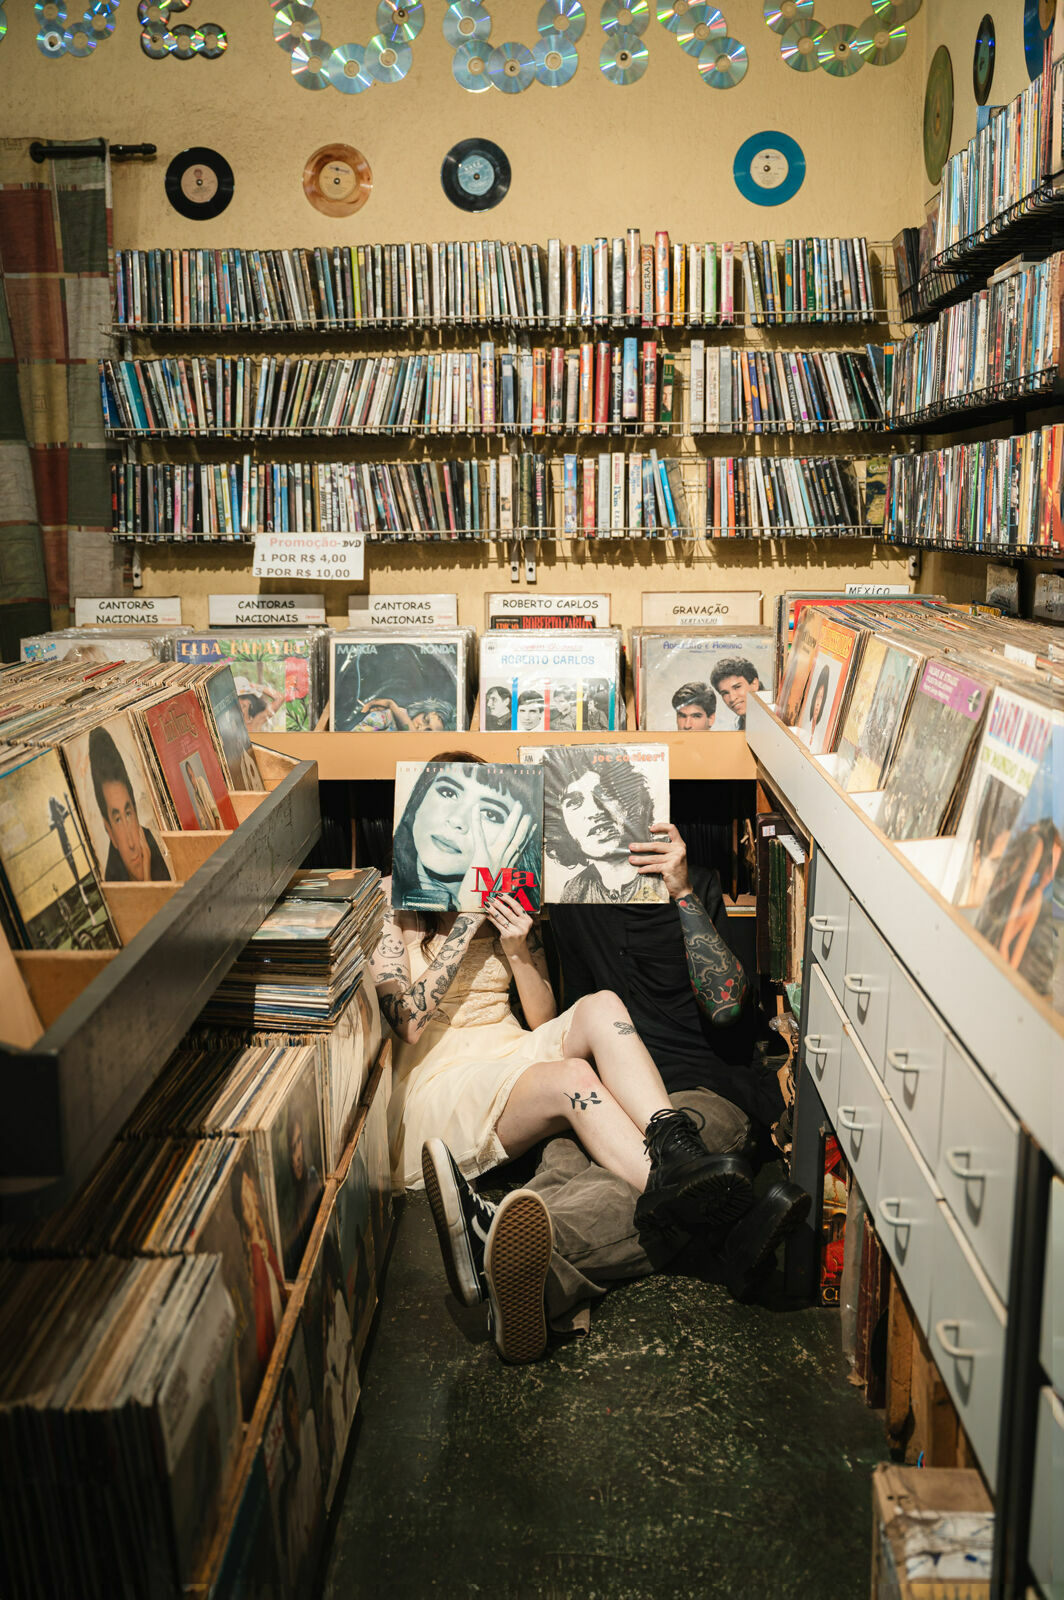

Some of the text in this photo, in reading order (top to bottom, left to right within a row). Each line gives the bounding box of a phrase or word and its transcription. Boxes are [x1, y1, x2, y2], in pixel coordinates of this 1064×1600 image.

[270, 537, 337, 549] Promoção
[272, 554, 296, 562] POR
[301, 554, 316, 563] R$
[320, 554, 346, 564] 4,00
[256, 568, 350, 579] 3 POR R$ 10,00
[98, 600, 154, 610] CANTORAS
[238, 600, 295, 608] CANTORAS
[374, 602, 431, 610] CANTORAS
[502, 600, 598, 608] ROBERTO CARLOS
[672, 604, 729, 616] GRAVAÇÃO
[96, 615, 158, 624] NACIONAIS
[236, 614, 298, 622] NACIONAIS
[371, 616, 434, 624] NACIONAIS
[522, 616, 593, 629] ROBERTO CARLOS
[182, 642, 222, 656] ELBA
[421, 644, 456, 654] RONDA
[502, 654, 595, 664] ROBERTO CARLOS
[592, 752, 612, 764] joe
